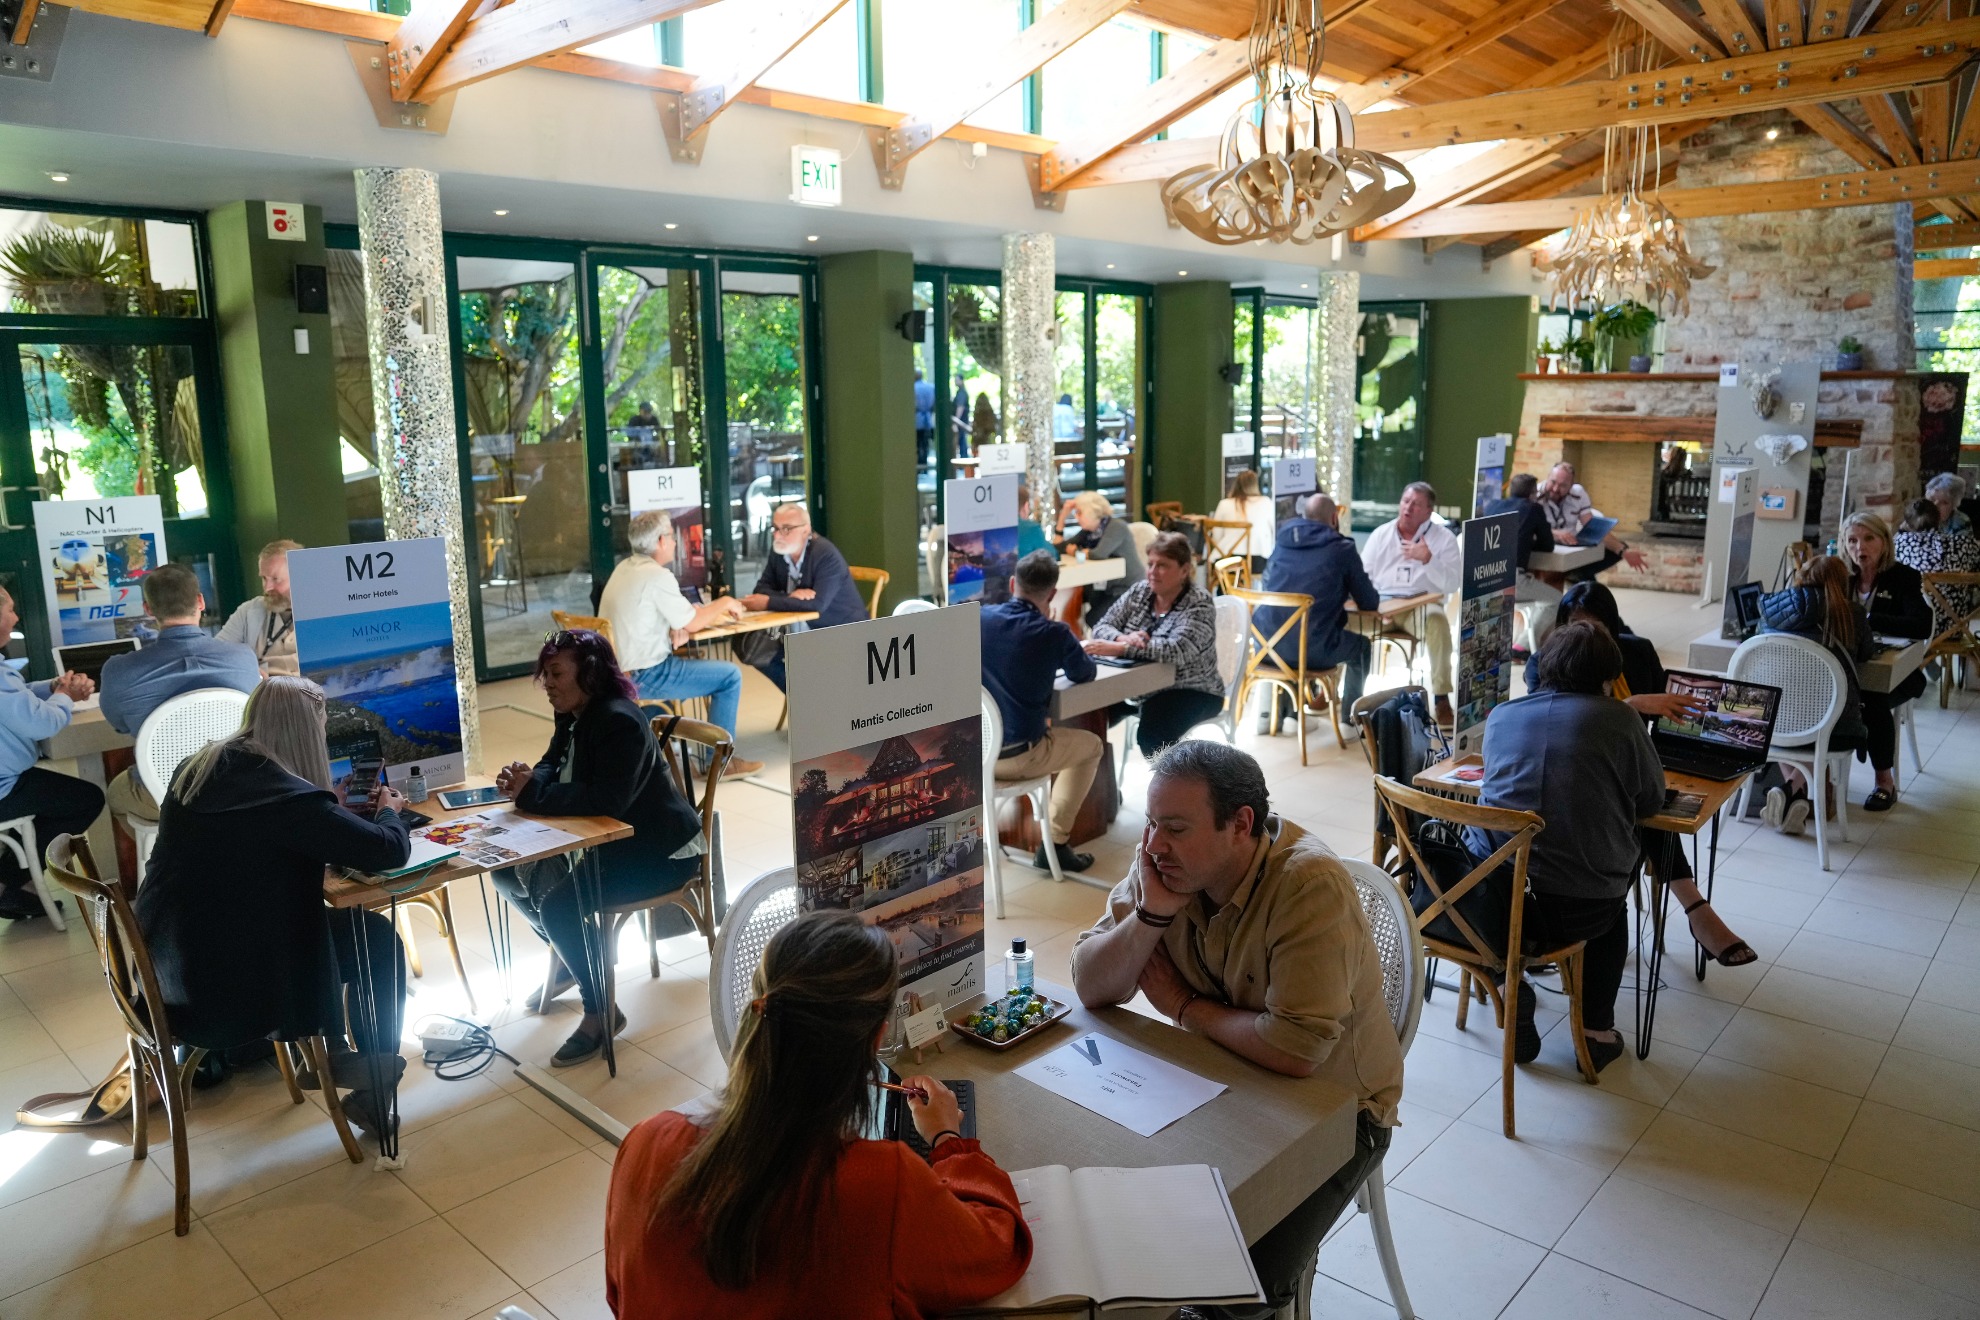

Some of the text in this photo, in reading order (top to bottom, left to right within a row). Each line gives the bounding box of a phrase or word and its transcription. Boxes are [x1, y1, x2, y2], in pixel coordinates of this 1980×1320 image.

[802, 160, 837, 190] EXIT
[997, 449, 1009, 461] S2
[1290, 463, 1301, 478] R3
[658, 475, 673, 490] R1
[86, 505, 115, 525] N1
[1484, 524, 1501, 551] N2
[345, 551, 396, 582] M2
[1473, 560, 1508, 581] NEWMARK
[348, 589, 399, 601] Minor Hotels
[89, 603, 127, 620] nac
[352, 621, 401, 637] MINOR
[867, 633, 916, 685] M1
[851, 702, 933, 731] Mantis Collection
[424, 764, 452, 775] MINOR
[947, 978, 976, 998] mantis
